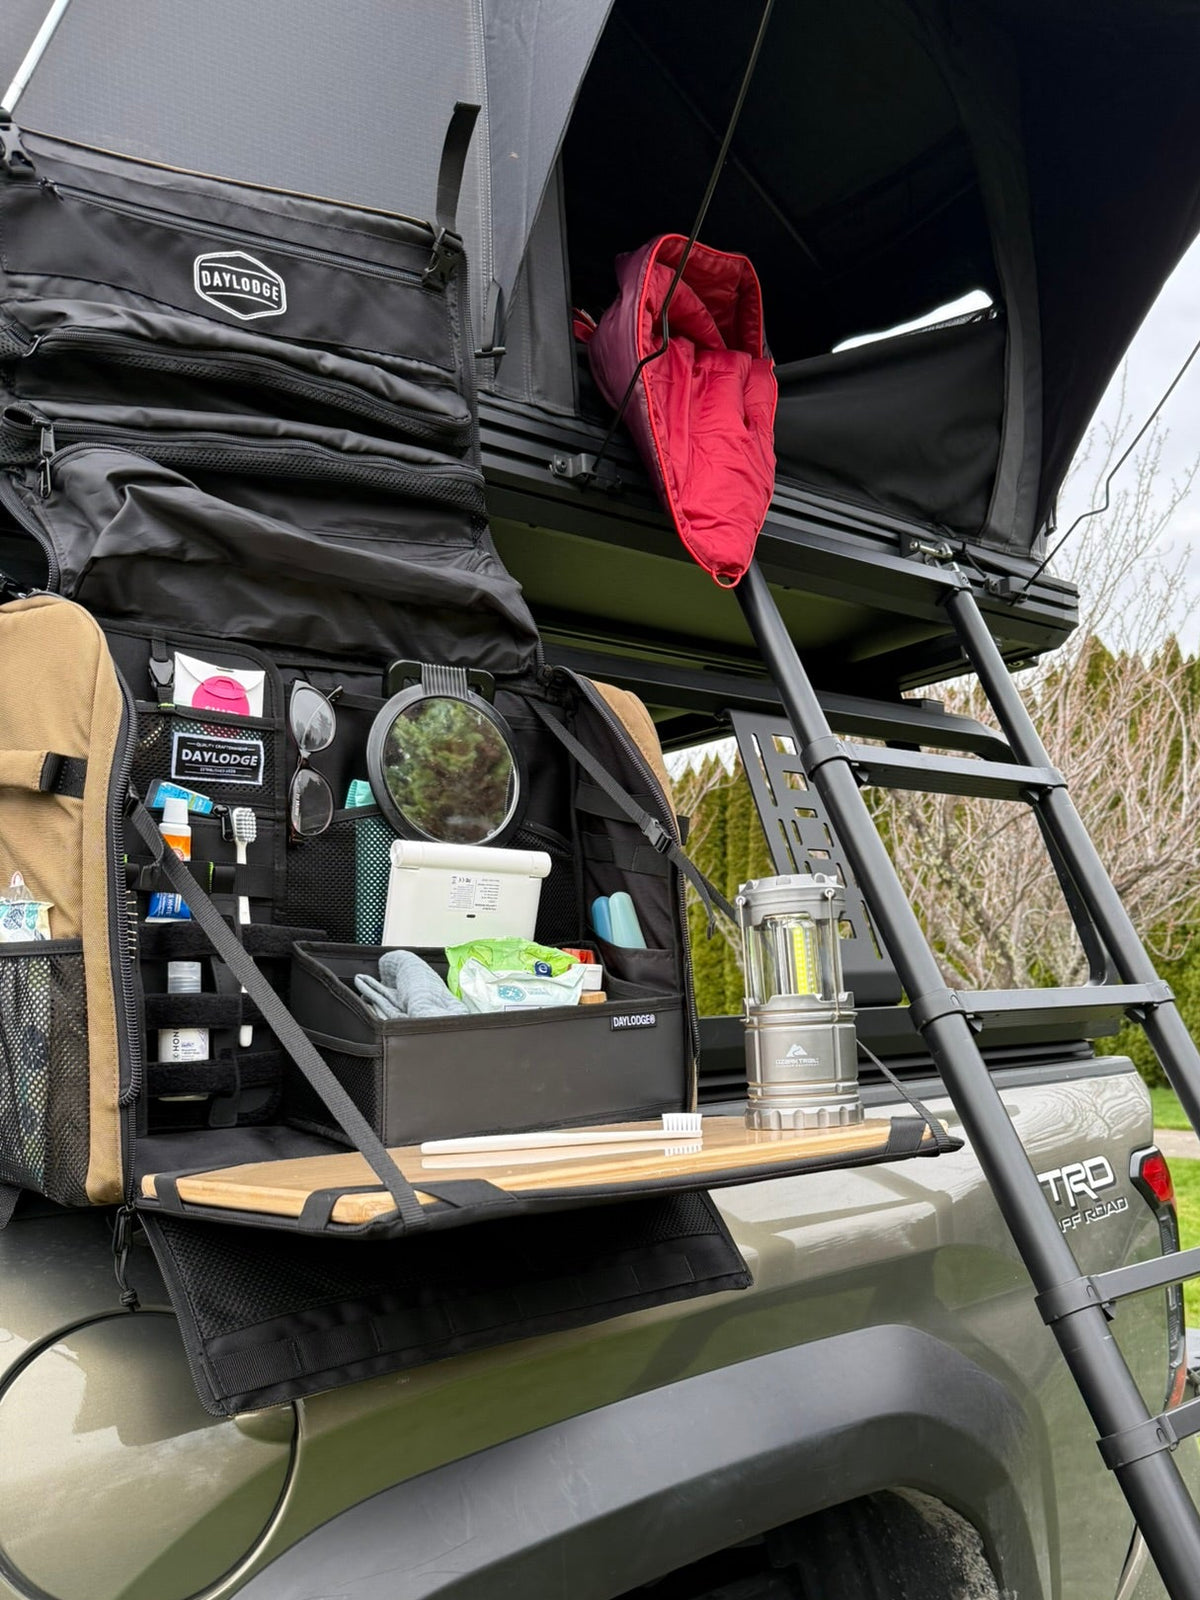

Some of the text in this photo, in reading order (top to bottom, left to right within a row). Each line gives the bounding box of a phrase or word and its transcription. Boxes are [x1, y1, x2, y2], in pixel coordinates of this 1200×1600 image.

[201, 270, 279, 301] DAYLODGE
[181, 748, 259, 766] DAYLODGE
[172, 1029, 180, 1051] HON
[1037, 1156, 1116, 1208] TRD
[1059, 1197, 1129, 1233] FF ROAD
